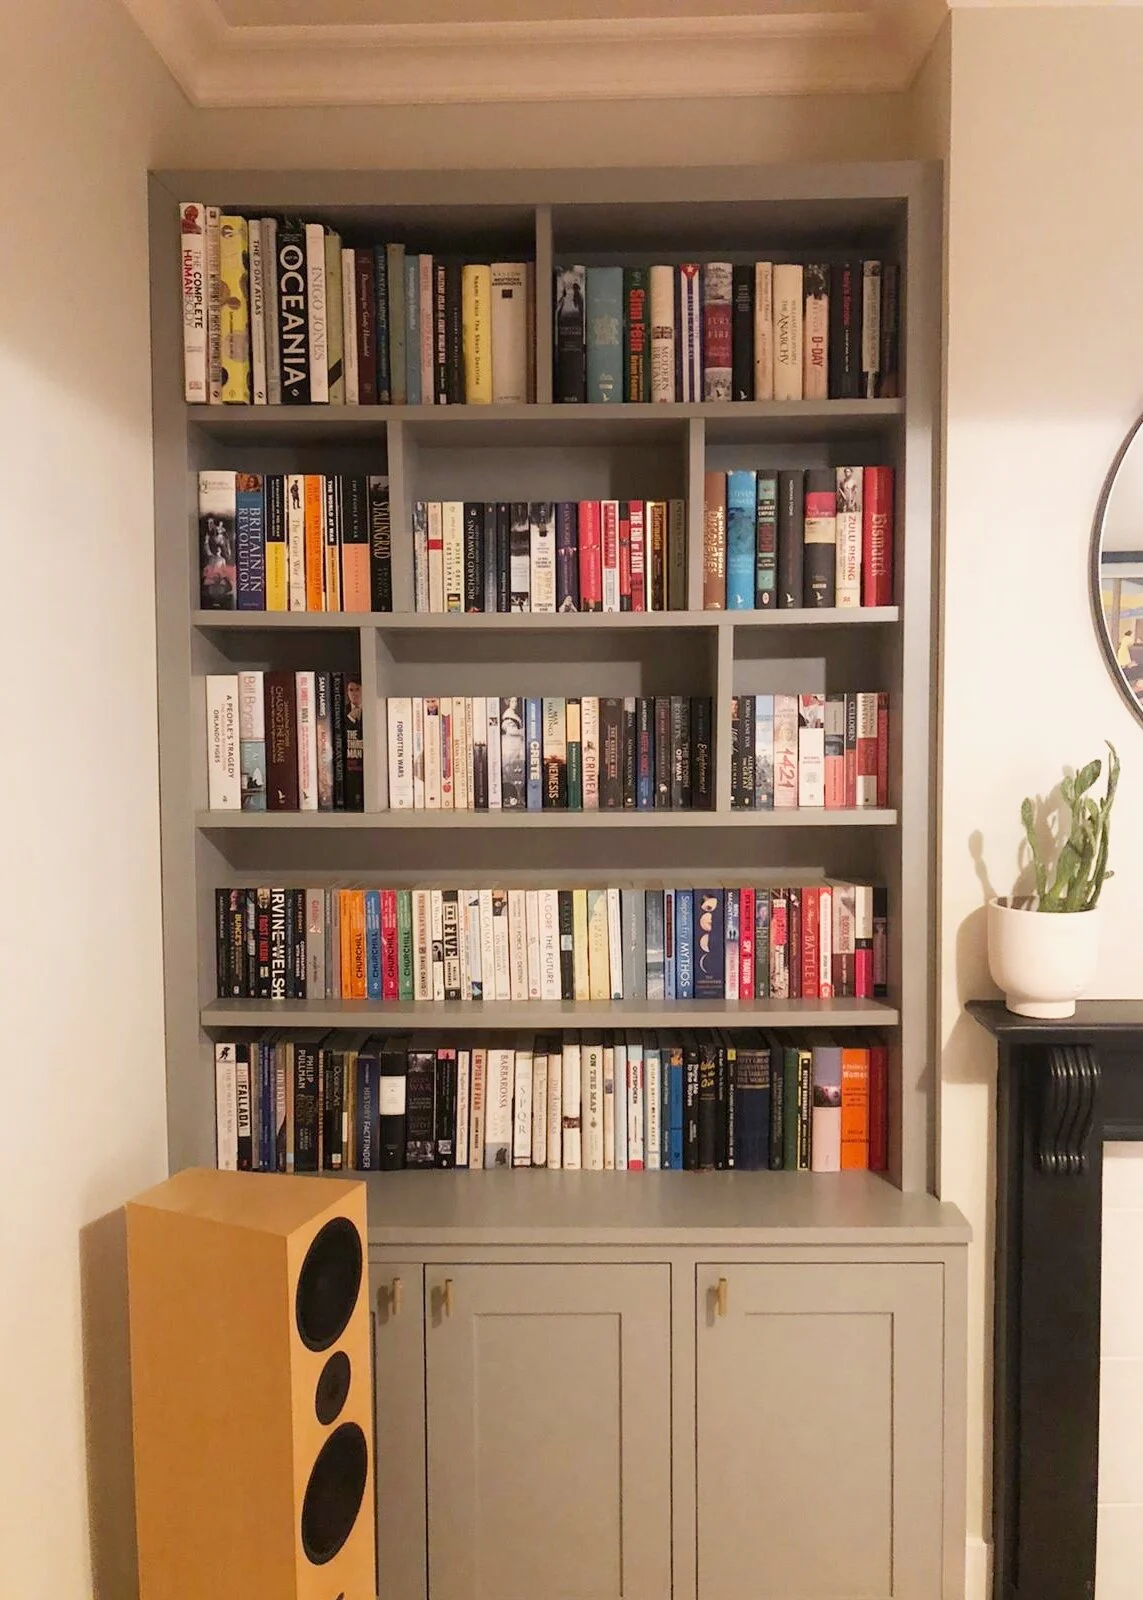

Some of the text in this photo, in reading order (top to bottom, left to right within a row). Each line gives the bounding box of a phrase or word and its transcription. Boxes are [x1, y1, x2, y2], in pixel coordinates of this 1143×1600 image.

[252, 240, 260, 256] THE
[194, 251, 203, 328] THE COMPLETE
[629, 289, 646, 321] Sinn
[279, 244, 306, 387] OCEANIA
[311, 266, 325, 361] INIGO JONES
[777, 313, 790, 366] ANARCHY
[811, 336, 824, 367] D-DAY
[652, 346, 661, 392] BRITAIN
[662, 346, 670, 392] MODERN
[292, 519, 301, 533] The
[372, 501, 391, 559] STALINGRAD
[630, 511, 643, 525] THE
[630, 527, 643, 542] END
[238, 507, 249, 592] REVOLUTION
[249, 507, 262, 592] BRITAIN IN
[292, 536, 301, 558] Great
[466, 520, 475, 600] RICHARD DAWKINS
[848, 515, 856, 581] ZULU RISING
[870, 512, 888, 577] Bismarck
[226, 703, 234, 740] PEOPLE'S
[242, 676, 256, 739] Bill Bryson
[276, 686, 284, 763] CHASING THE FLAME
[848, 701, 856, 742] CULLODEN
[396, 720, 404, 758] FORGOTTEN
[227, 742, 235, 779] TRAGEDY
[530, 740, 540, 781] CRETE
[548, 762, 559, 799] NEMESIS
[585, 756, 596, 796] CRIMEA
[776, 748, 796, 788] 1421
[234, 914, 242, 946] BUNCE'S
[271, 888, 285, 1000] IRVINE WELSH
[444, 923, 458, 958] FIVE
[545, 935, 553, 950] THE
[680, 895, 690, 987] Stephen Fry MYTHOS
[355, 932, 363, 979] CHURCHILL
[371, 932, 379, 978] CHURCHILL
[546, 953, 554, 984] FUTURE
[804, 935, 815, 977] BATTLE
[298, 1049, 306, 1089] PULLMAN
[306, 1055, 314, 1083] PHILIP
[590, 1053, 597, 1067] ON
[499, 1054, 509, 1109] BARBAROSSA
[238, 1084, 249, 1128] FALLADA
[362, 1120, 371, 1169] FACTFINDER
